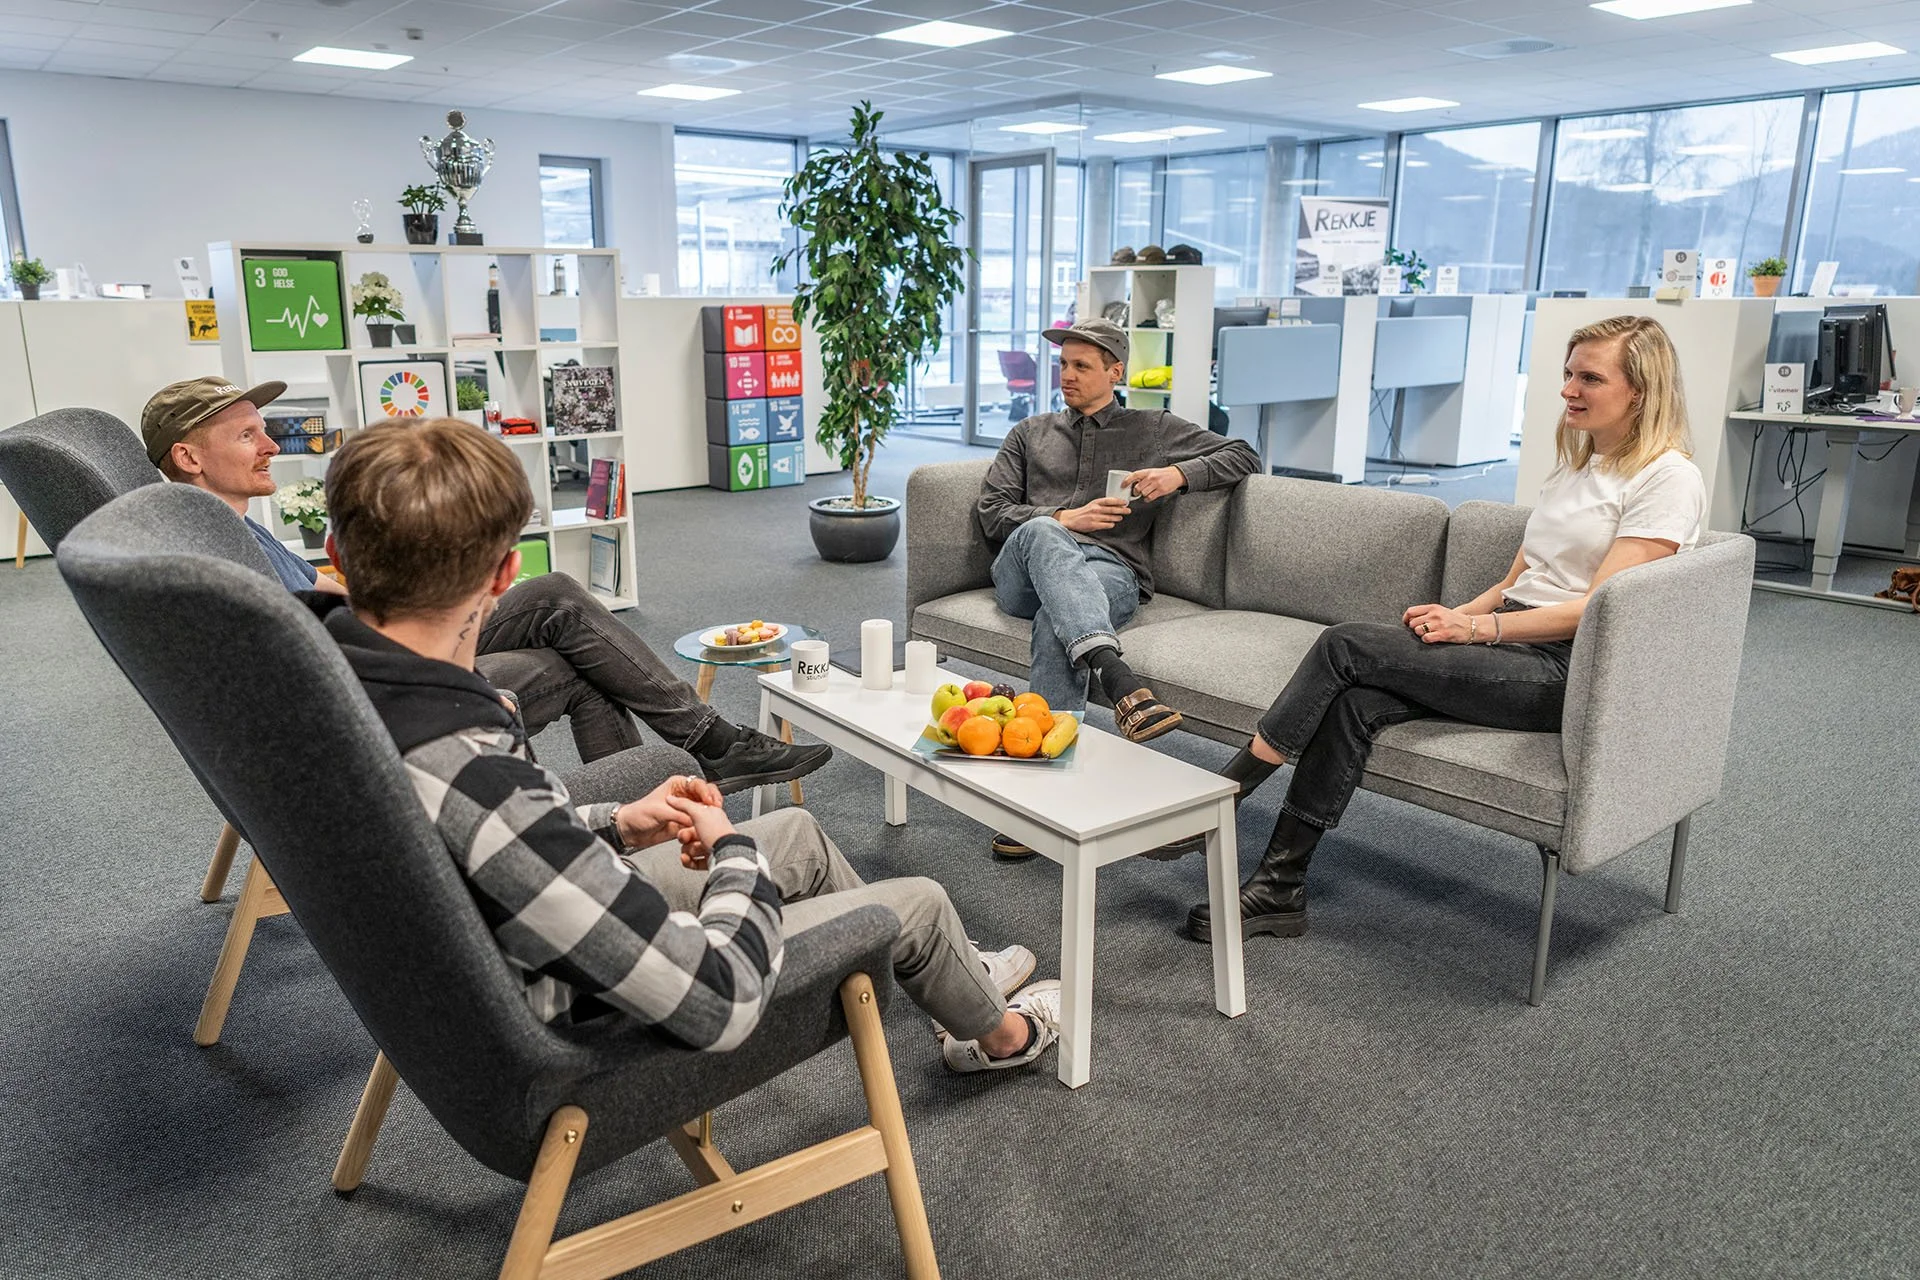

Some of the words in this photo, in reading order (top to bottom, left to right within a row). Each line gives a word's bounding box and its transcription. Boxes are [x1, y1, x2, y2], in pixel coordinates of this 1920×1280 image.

[1314, 208, 1377, 232] REKKJE
[255, 267, 266, 288] 3
[272, 268, 289, 277] GOD
[273, 279, 295, 288] HELSE
[728, 308, 734, 320] 4
[728, 356, 738, 368] 10
[769, 355, 775, 366] 1
